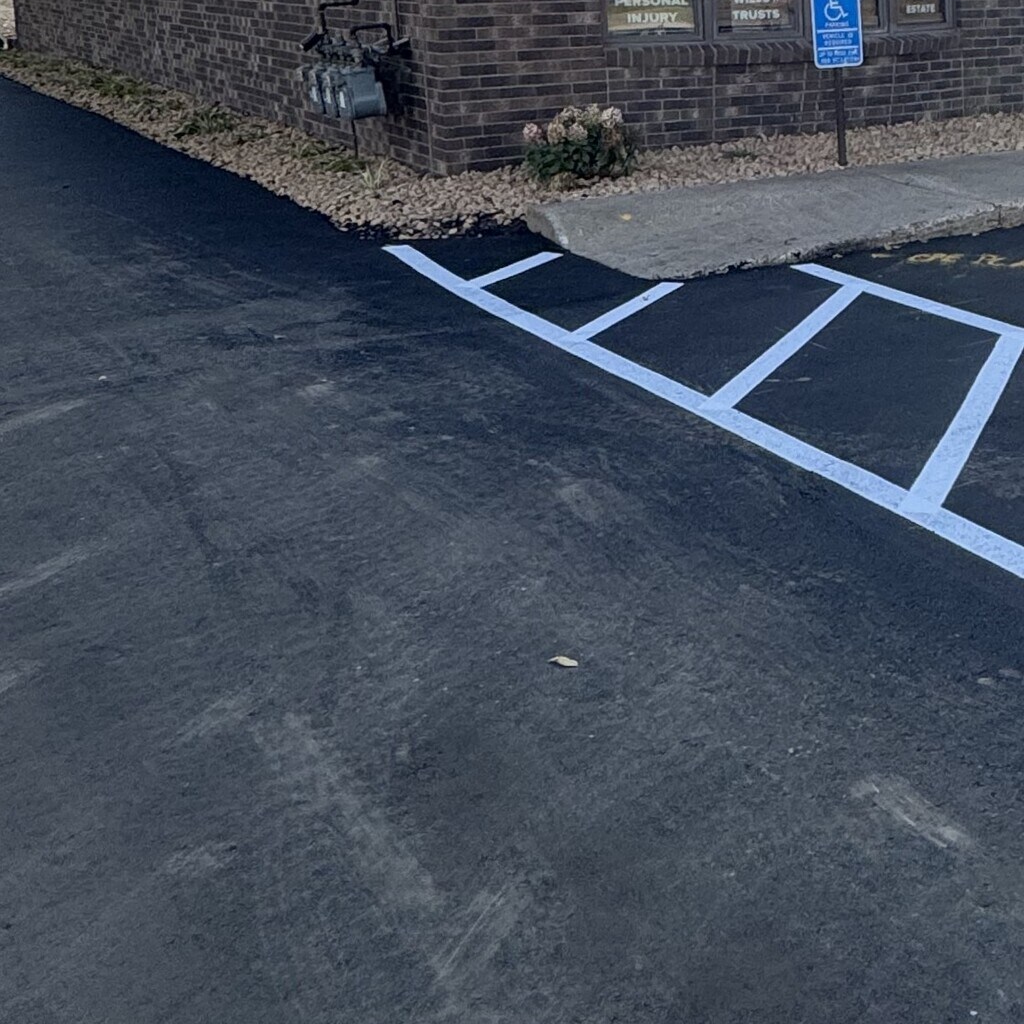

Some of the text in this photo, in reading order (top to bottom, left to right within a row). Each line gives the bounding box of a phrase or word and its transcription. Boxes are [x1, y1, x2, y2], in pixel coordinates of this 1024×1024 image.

[732, 9, 780, 20] TRUSTS
[906, 4, 936, 14] ESTATE
[626, 12, 678, 23] INJURY
